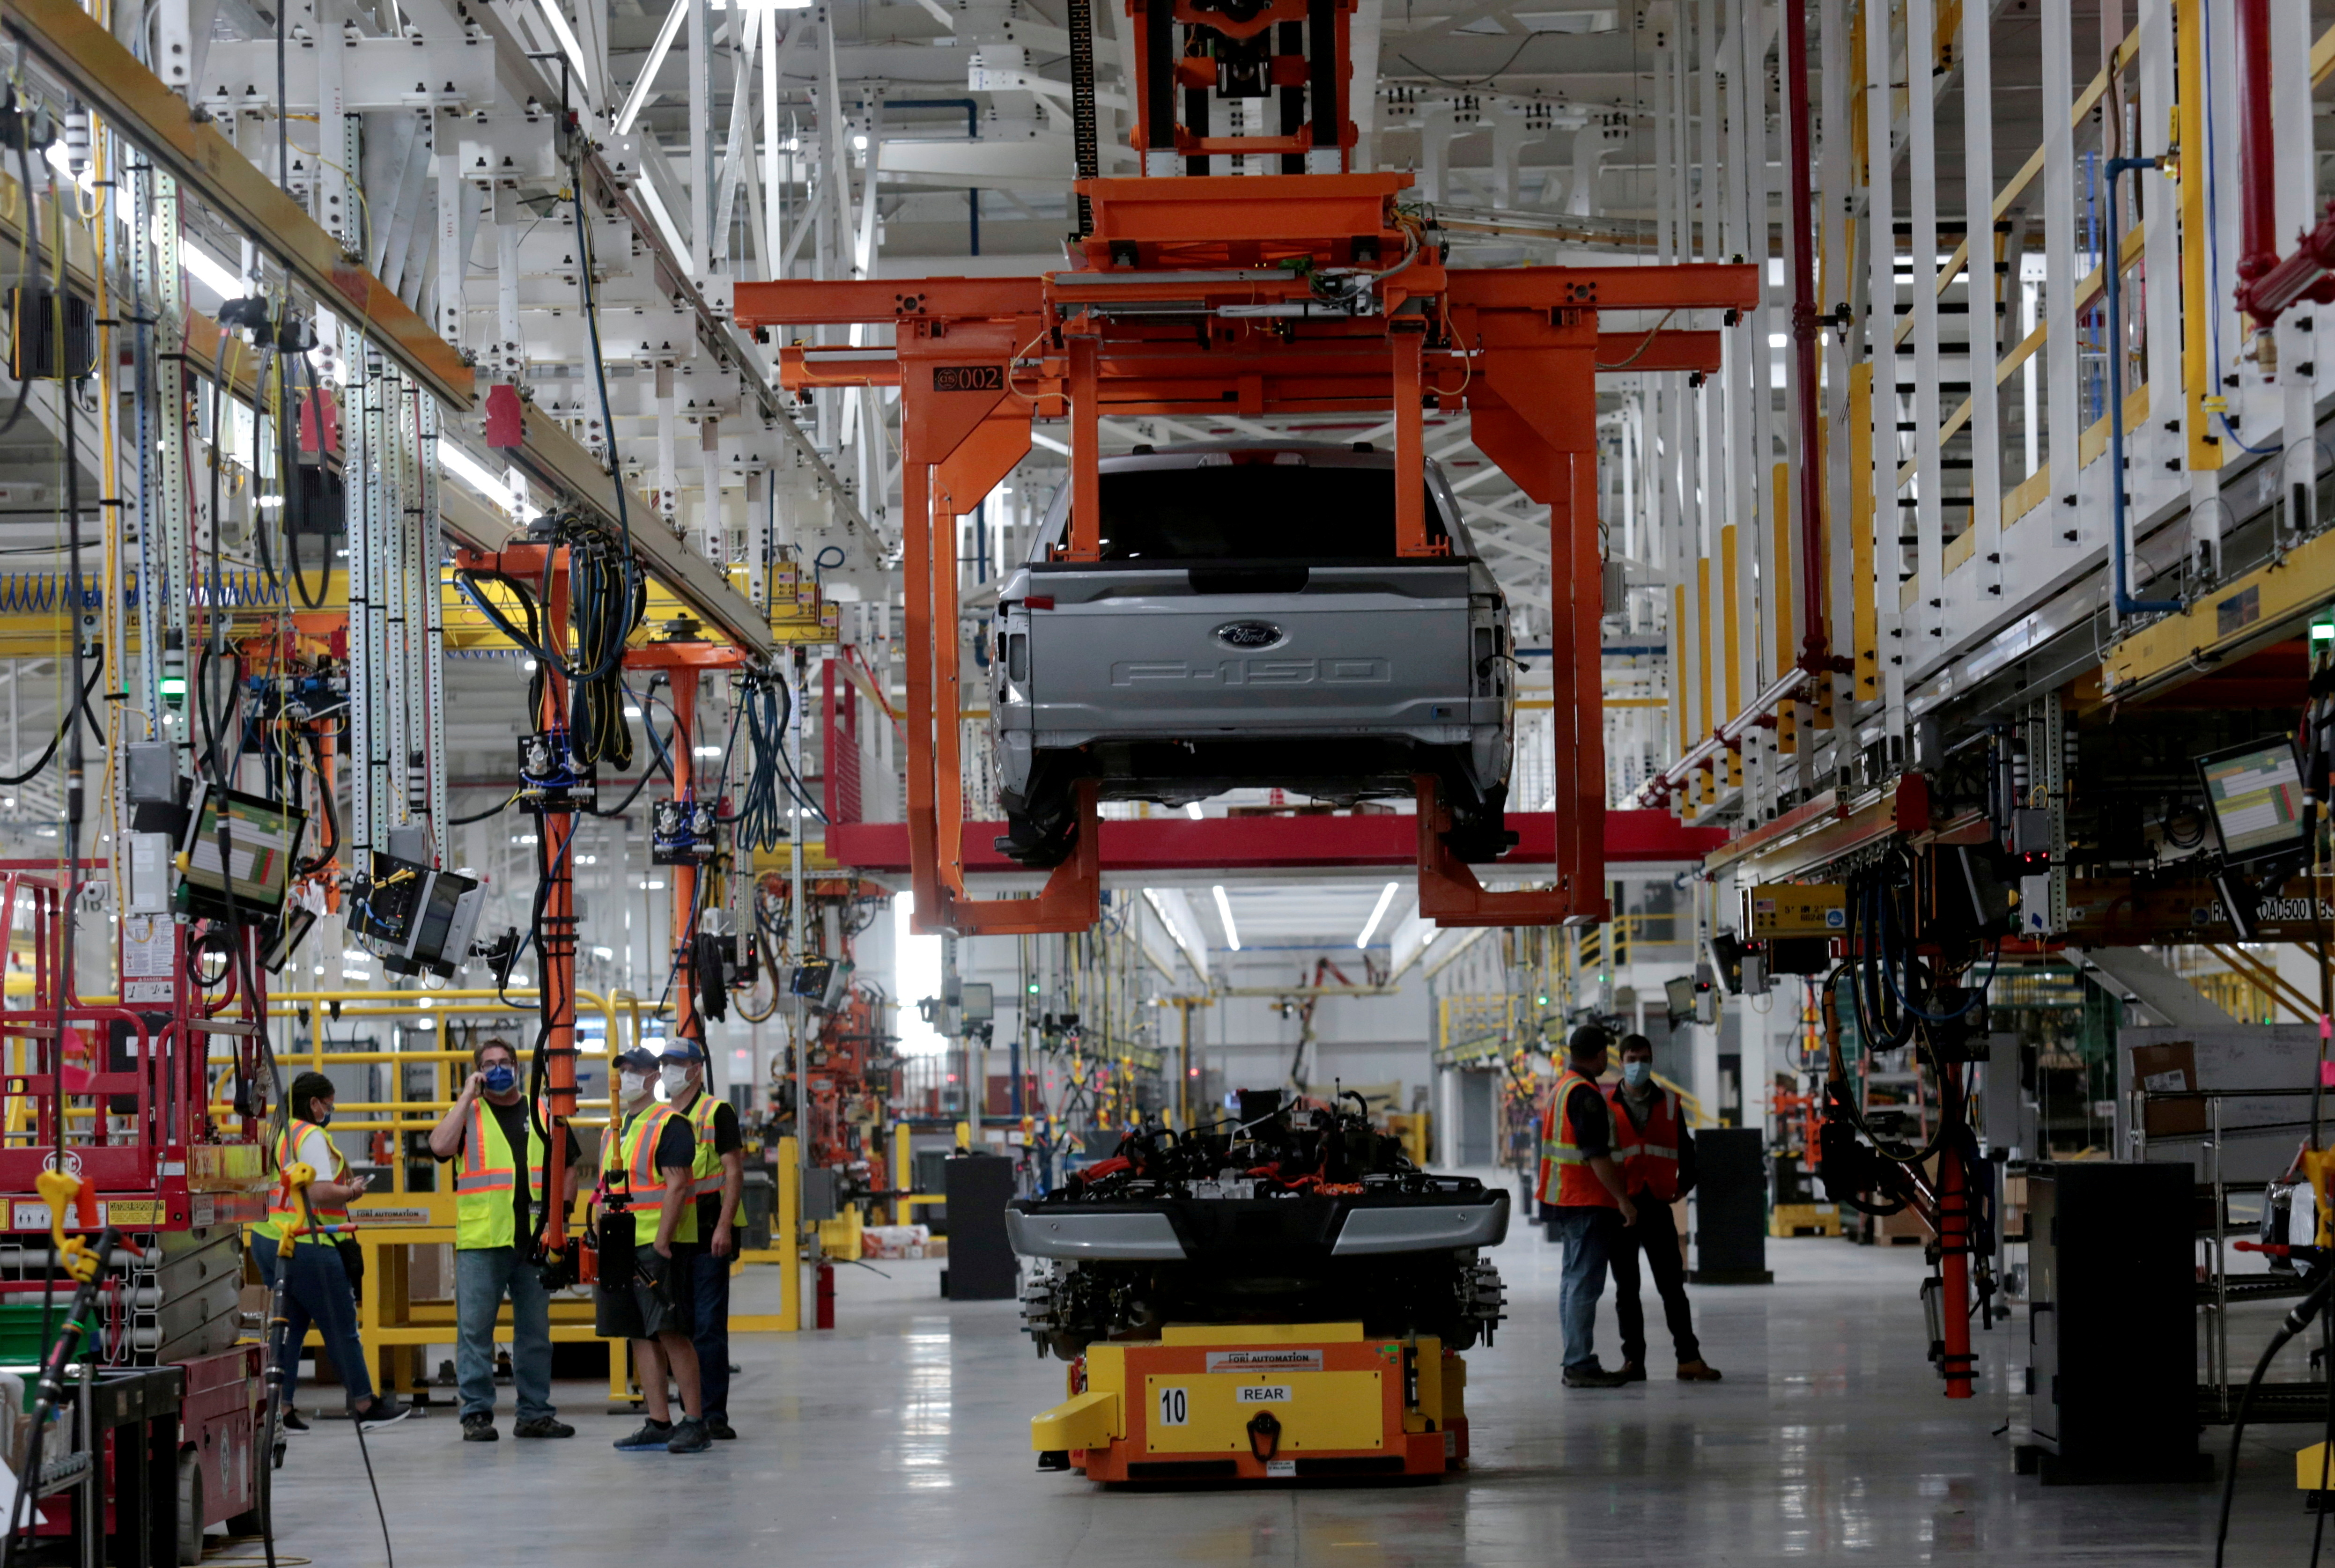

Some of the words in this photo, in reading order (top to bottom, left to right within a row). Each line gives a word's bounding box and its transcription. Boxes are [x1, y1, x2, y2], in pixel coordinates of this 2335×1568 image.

[959, 367, 998, 388] 002
[1233, 628, 1268, 643] Ford
[1110, 659, 1392, 686] F-150
[1244, 1388, 1285, 1400] REAR
[1162, 1389, 1186, 1423] 10
